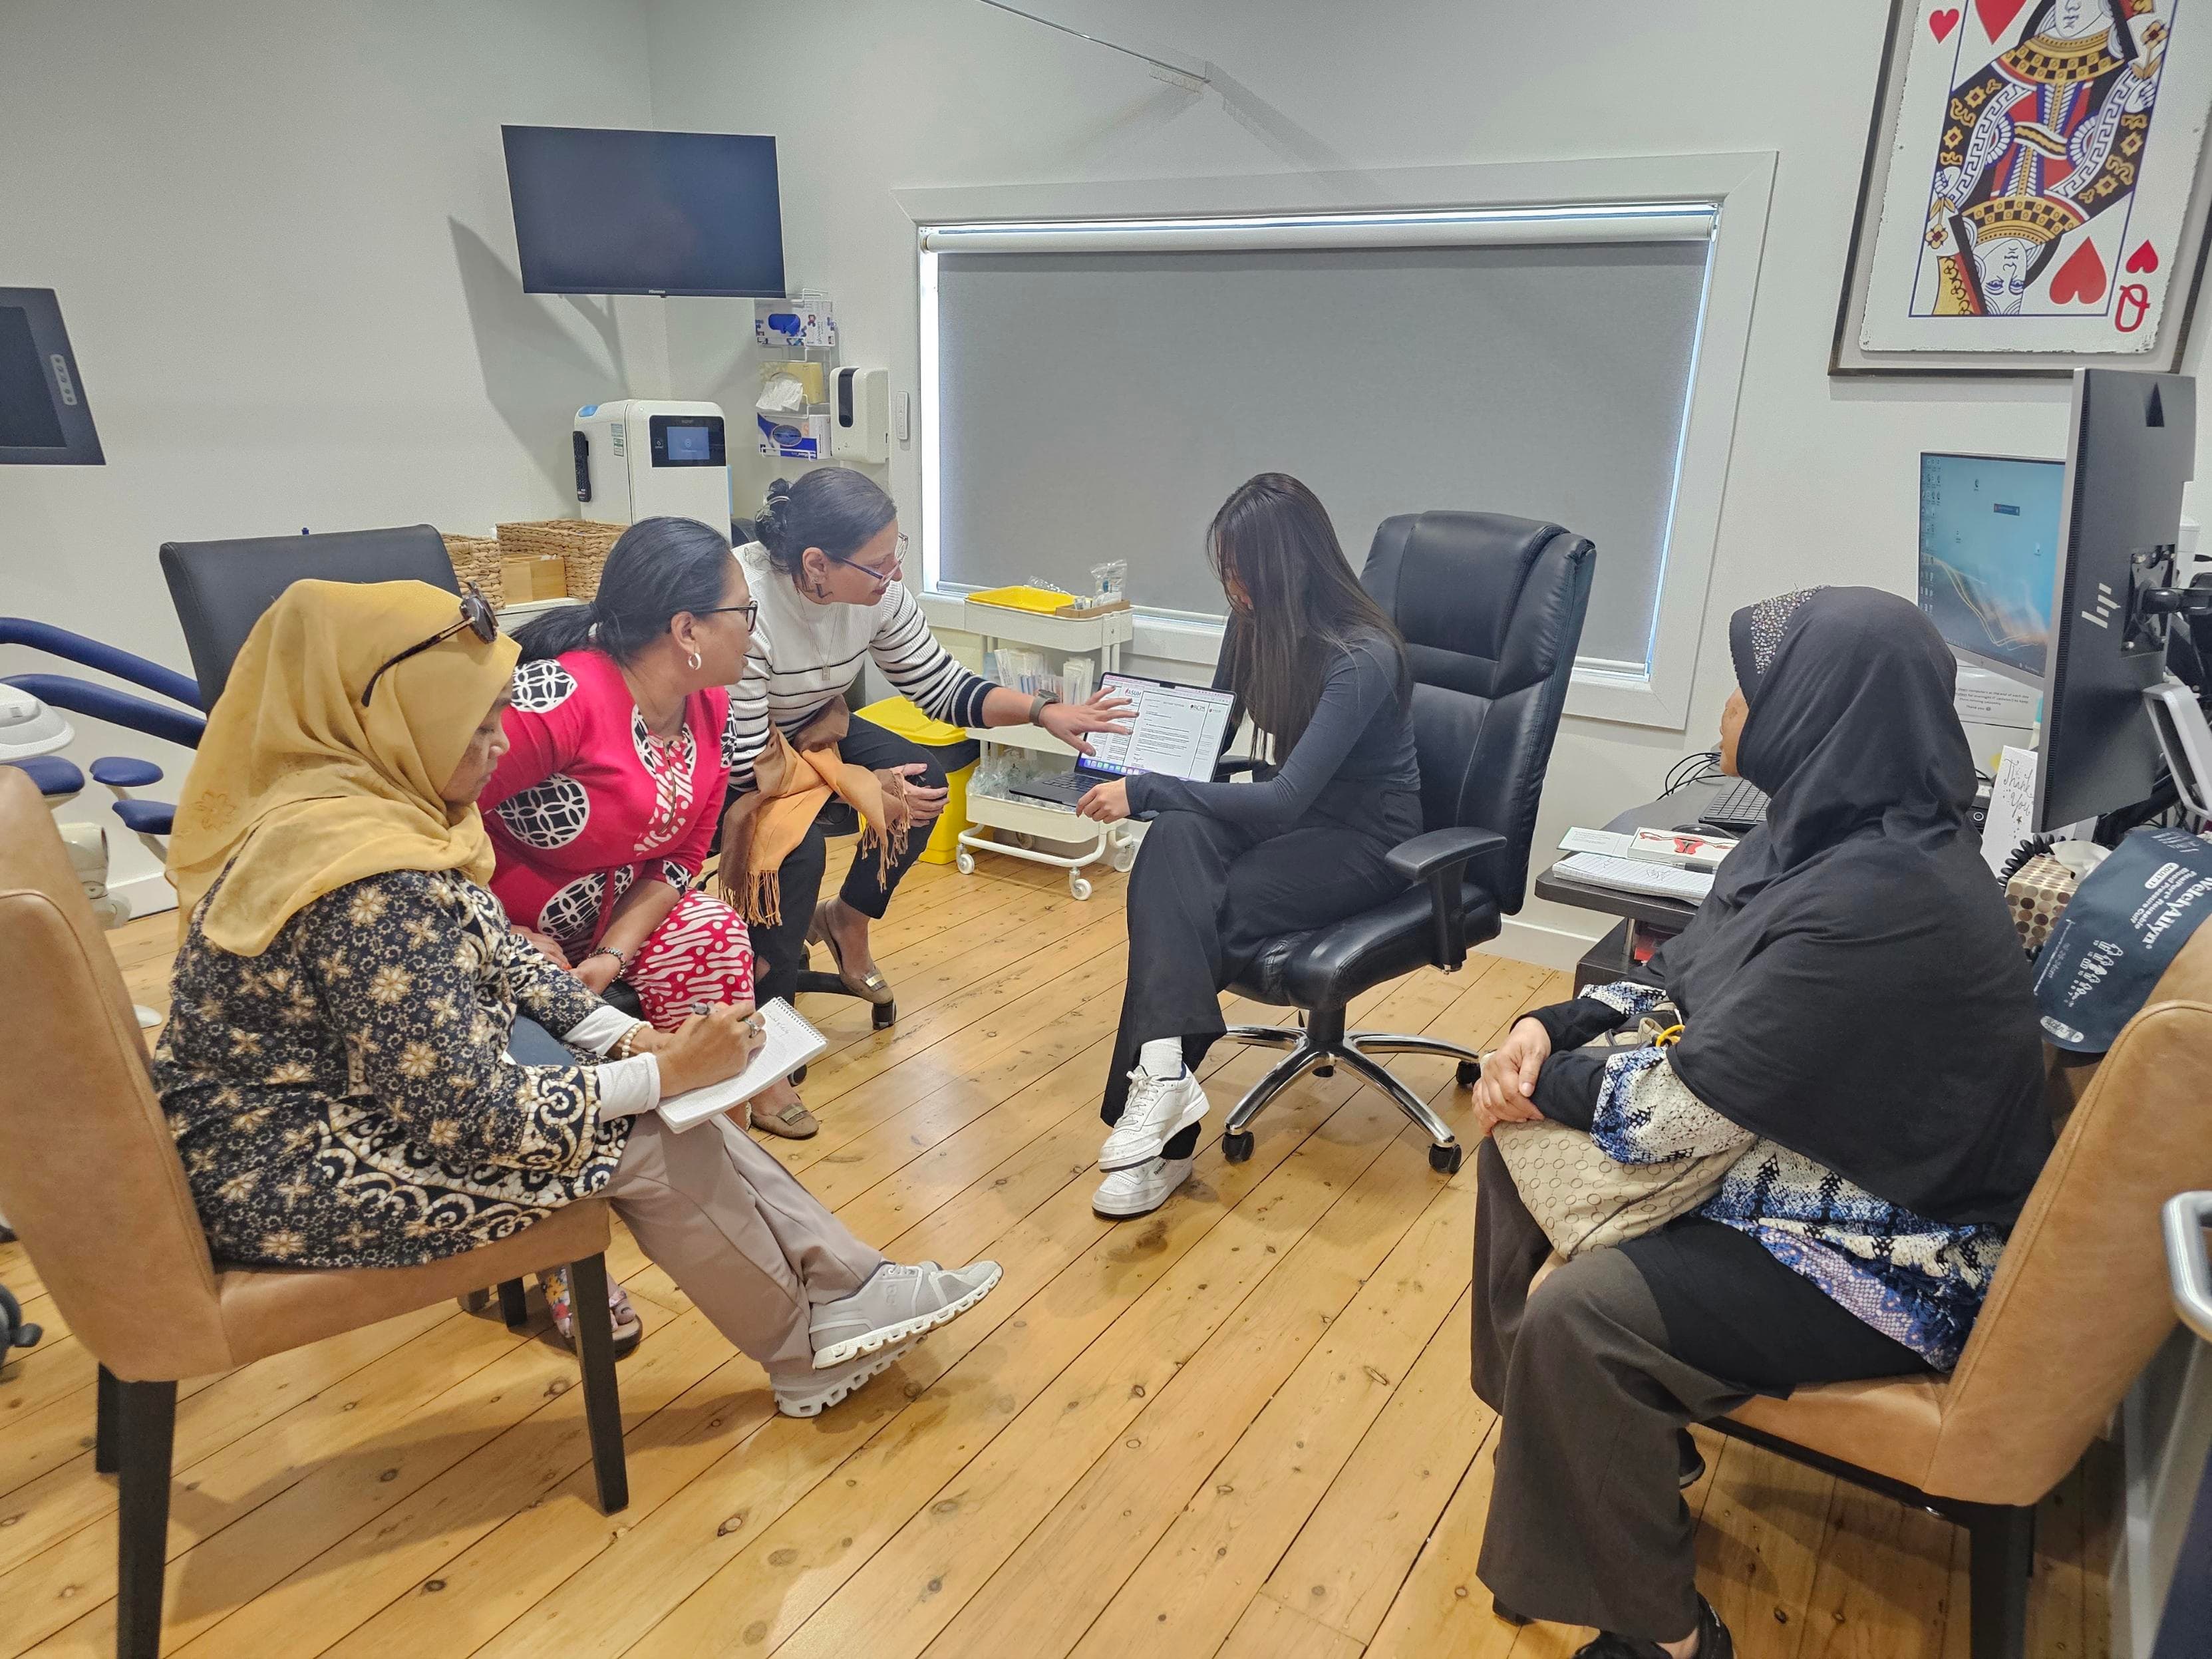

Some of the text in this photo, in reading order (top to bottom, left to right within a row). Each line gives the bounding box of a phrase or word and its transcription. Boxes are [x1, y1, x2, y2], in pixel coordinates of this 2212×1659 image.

[2114, 283, 2151, 333] Q
[2130, 867, 2190, 924] Blood Pressure Cuff
[2134, 897, 2165, 930] Reusable
